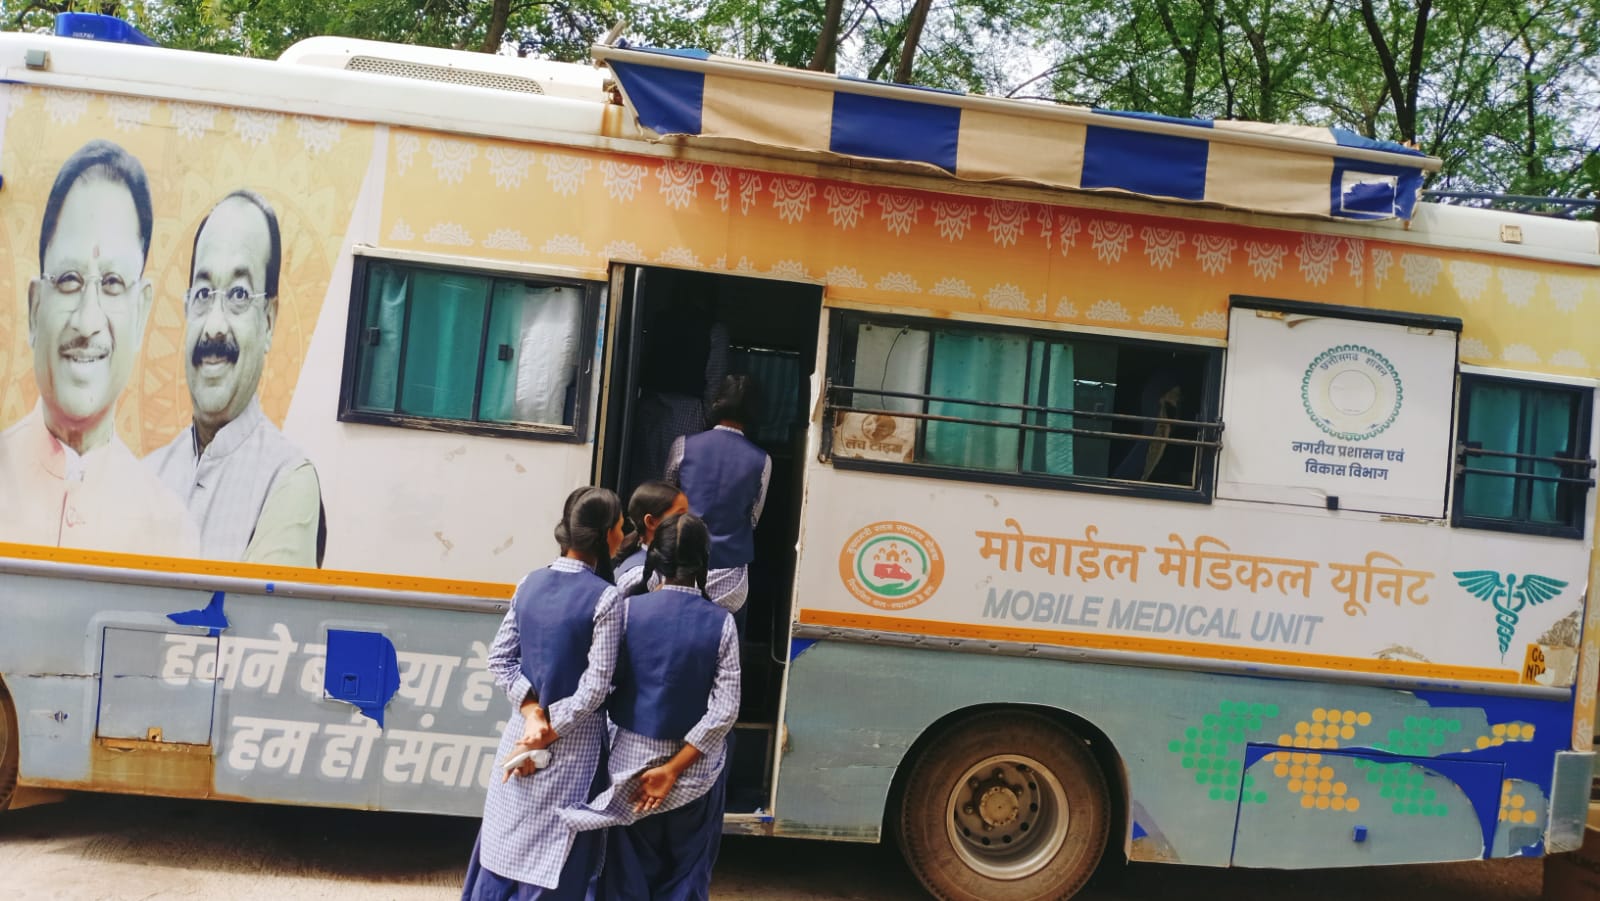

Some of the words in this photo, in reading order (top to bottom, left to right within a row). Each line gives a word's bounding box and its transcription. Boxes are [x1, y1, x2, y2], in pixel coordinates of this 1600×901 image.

[1292, 440, 1336, 457] नगरीय
[1338, 445, 1385, 461] प्रशासन
[1387, 448, 1405, 463] एवं
[1305, 458, 1347, 476] विकास
[1349, 462, 1389, 480] विभाग
[975, 518, 1147, 583] मोबाईल
[1155, 533, 1319, 598] मेडिकल
[1329, 551, 1435, 616] यूनिट
[982, 588, 1103, 627] MOBILE
[1107, 601, 1241, 639] MEDICAL
[1251, 611, 1324, 645] UNIT
[162, 623, 298, 694] हमने
[228, 716, 320, 774] हम
